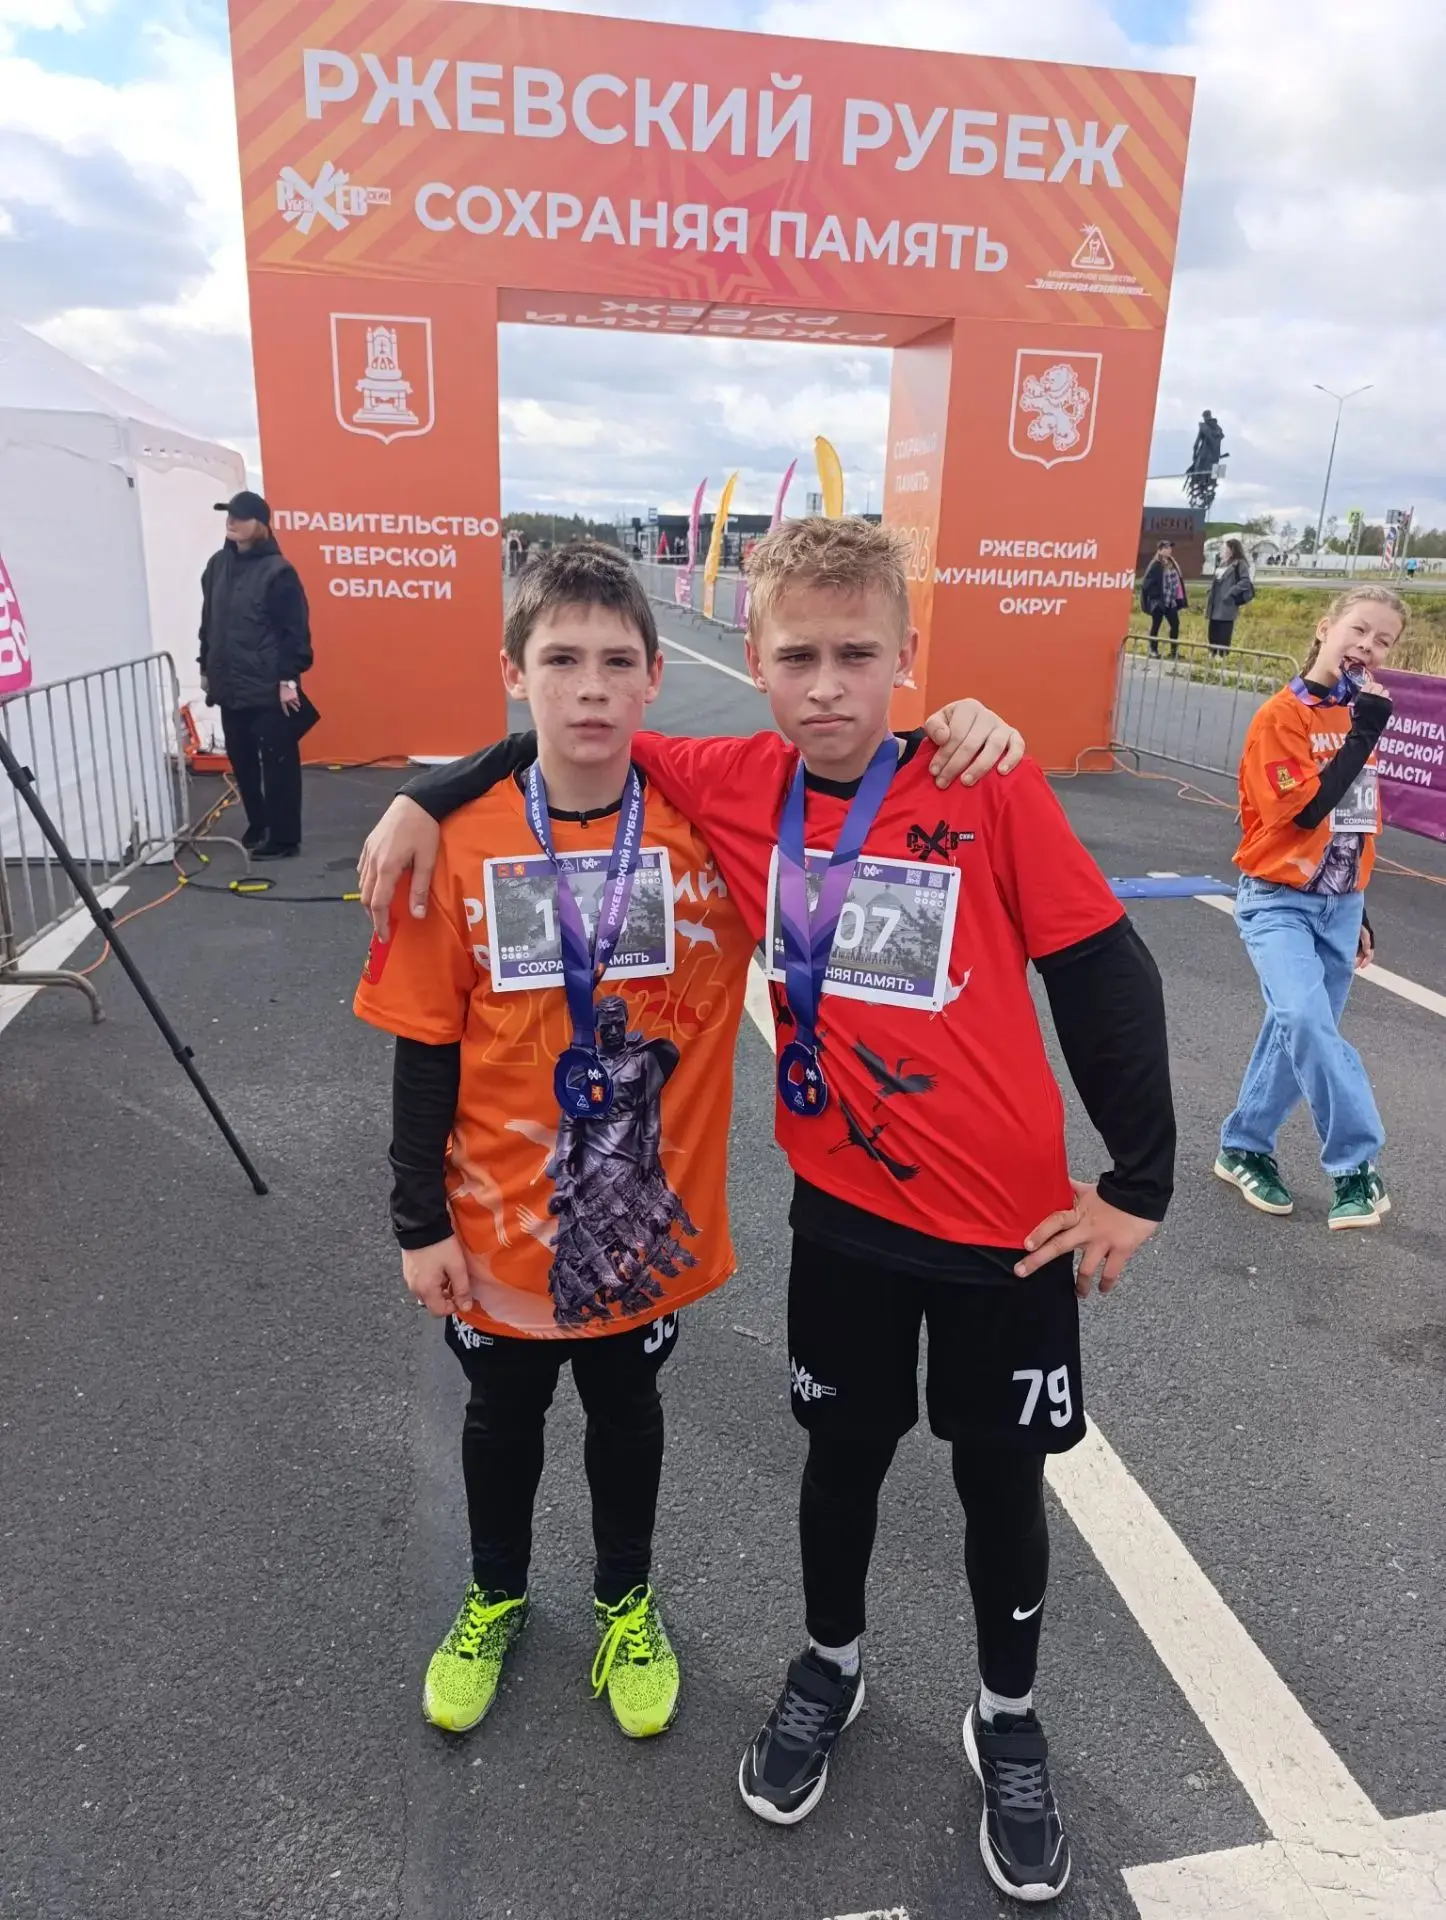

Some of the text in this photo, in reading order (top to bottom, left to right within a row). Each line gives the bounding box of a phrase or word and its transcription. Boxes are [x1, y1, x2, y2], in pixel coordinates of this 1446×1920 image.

[302, 48, 1130, 188] РЖЕВСКИЙ РУБЕЖ
[414, 182, 1009, 273] СОХРАНЯЯ ПАМЯТЬ
[525, 309, 889, 342] РЖЕВСКИЙ
[600, 300, 839, 327] РУБЕЖ
[273, 510, 499, 537] ПРАВИТЕЛЬСТВО
[319, 544, 457, 568] ТВЕРСКОЙ
[979, 539, 1098, 560] РЖЕВСКИЙ
[328, 577, 453, 600] ОБЛАСТИ
[932, 568, 1136, 590] МУНИЦИПАЛЬНЫЙ
[999, 597, 1067, 616] ОКРУГ
[1386, 715, 1446, 742] РАВИТЕЛ
[1354, 786, 1378, 811] 10
[607, 850, 632, 926] РЖЕВСКИЙ
[623, 799, 640, 847] РУБЕЖ
[833, 902, 901, 954] 07
[518, 952, 650, 975] СОХРА МЯТЬ
[853, 970, 915, 992] ПАМЯТЬ
[1012, 1364, 1073, 1428] 79
